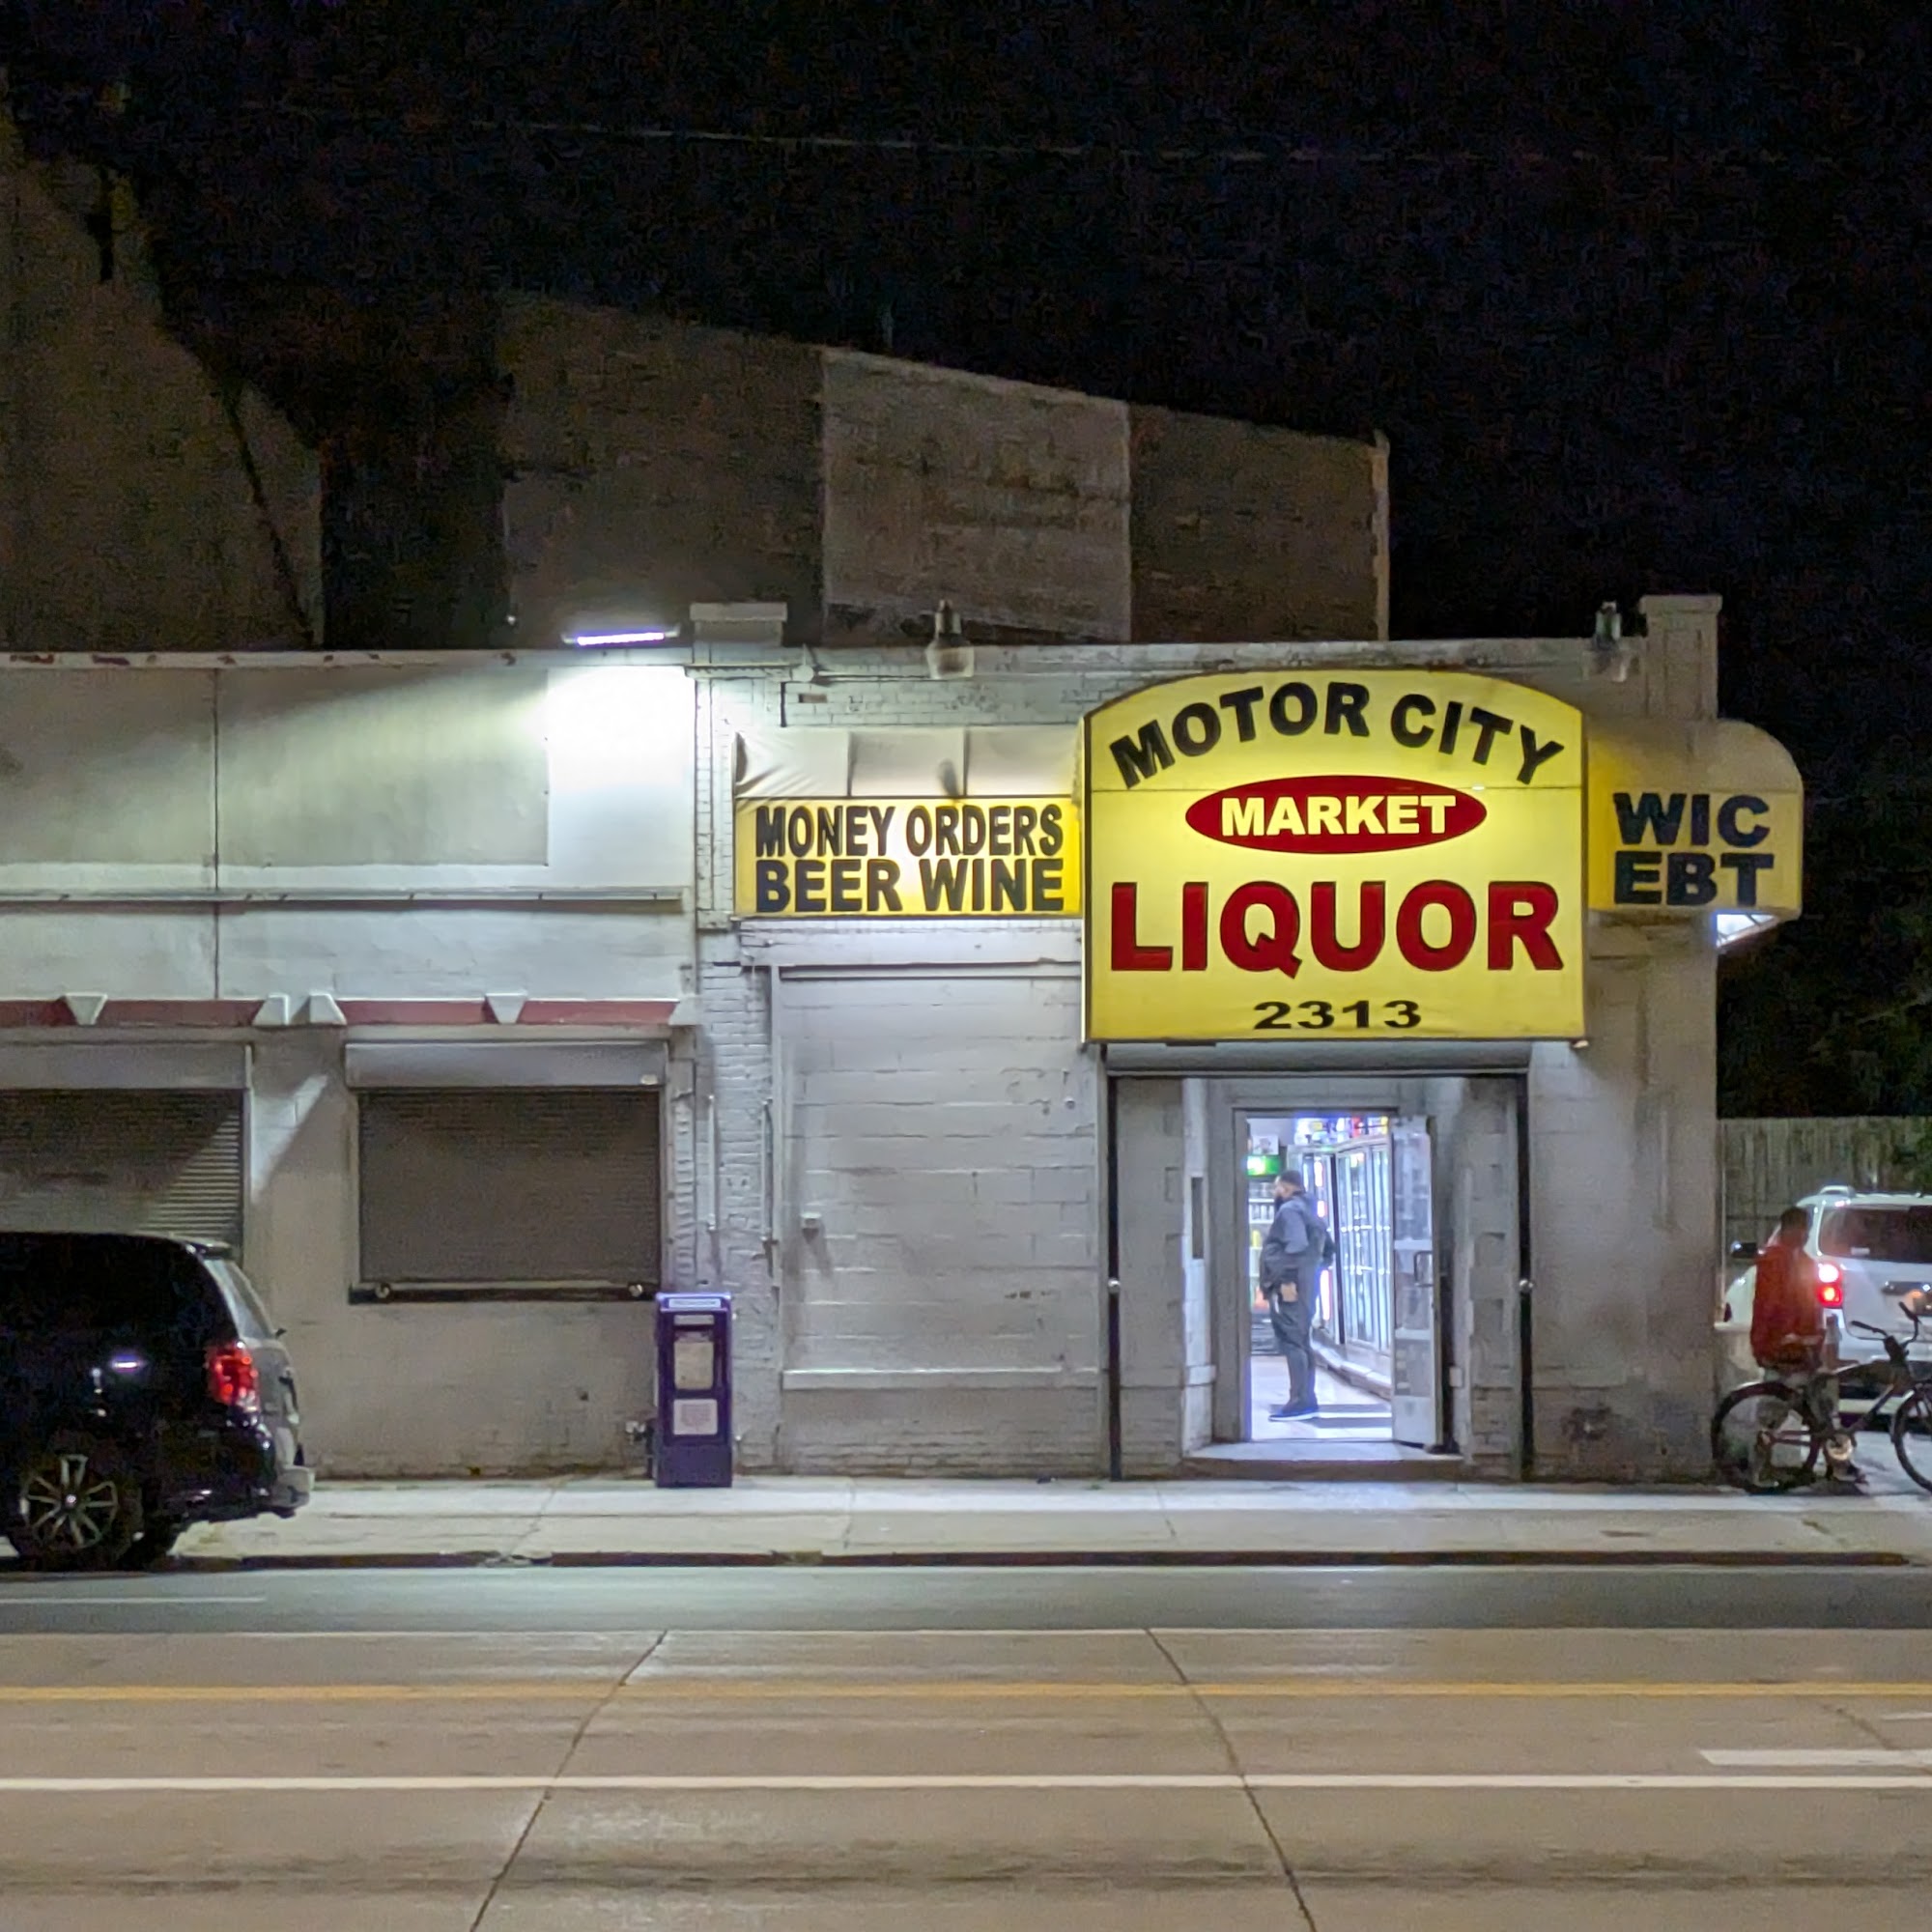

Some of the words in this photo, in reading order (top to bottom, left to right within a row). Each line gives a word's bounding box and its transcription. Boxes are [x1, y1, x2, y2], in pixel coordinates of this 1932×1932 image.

[1109, 681, 1370, 789] MOTOR
[1390, 694, 1565, 784] CITY
[755, 805, 895, 857] MONEY
[906, 804, 1064, 856] ORDERS
[1221, 796, 1457, 837] MARKET
[1613, 793, 1770, 847] WIC
[755, 859, 902, 912] BEER
[920, 858, 1064, 912] WINE
[1614, 852, 1774, 906] EBT
[1110, 880, 1565, 980] LIQUOR
[1254, 1000, 1422, 1030] 2313
